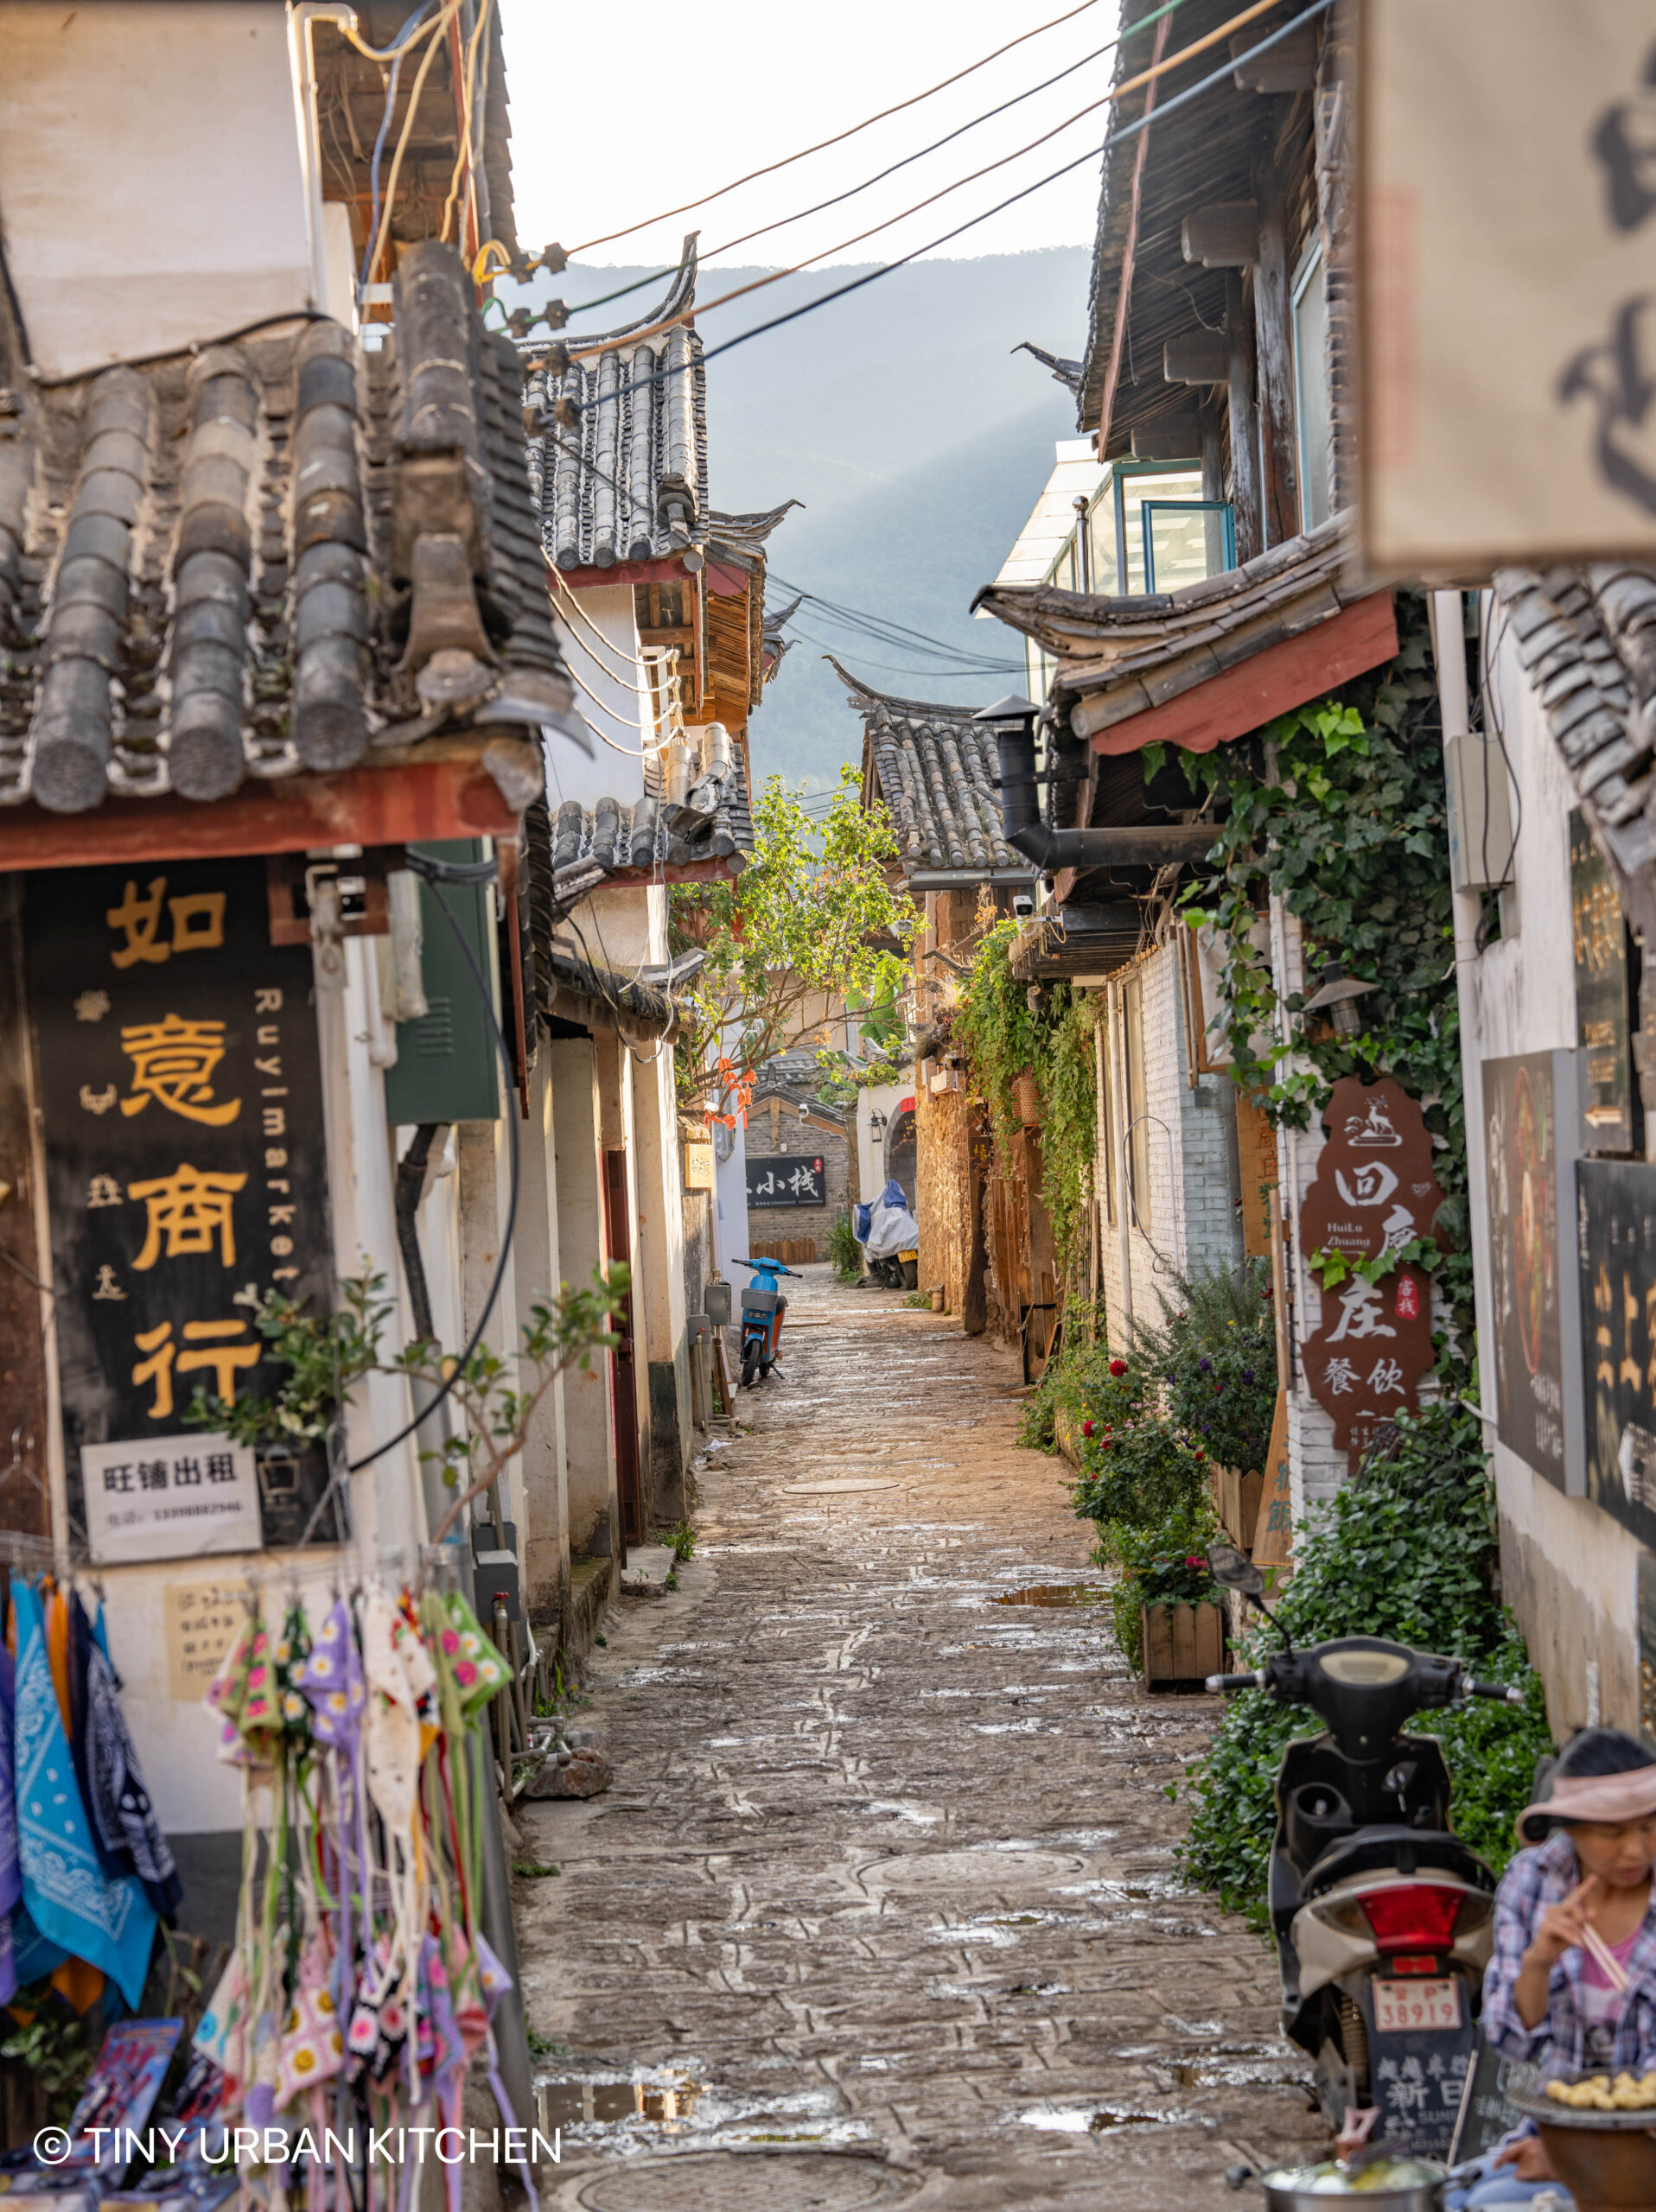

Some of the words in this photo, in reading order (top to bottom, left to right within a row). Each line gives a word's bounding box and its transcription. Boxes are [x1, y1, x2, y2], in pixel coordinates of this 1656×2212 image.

[106, 876, 261, 1419] 如意商行
[746, 1166, 819, 1198] 小栈
[1328, 1236, 1371, 1249] Zhuang
[1398, 1280, 1416, 1315] 客栈
[1322, 1357, 1406, 1395] 餐饮
